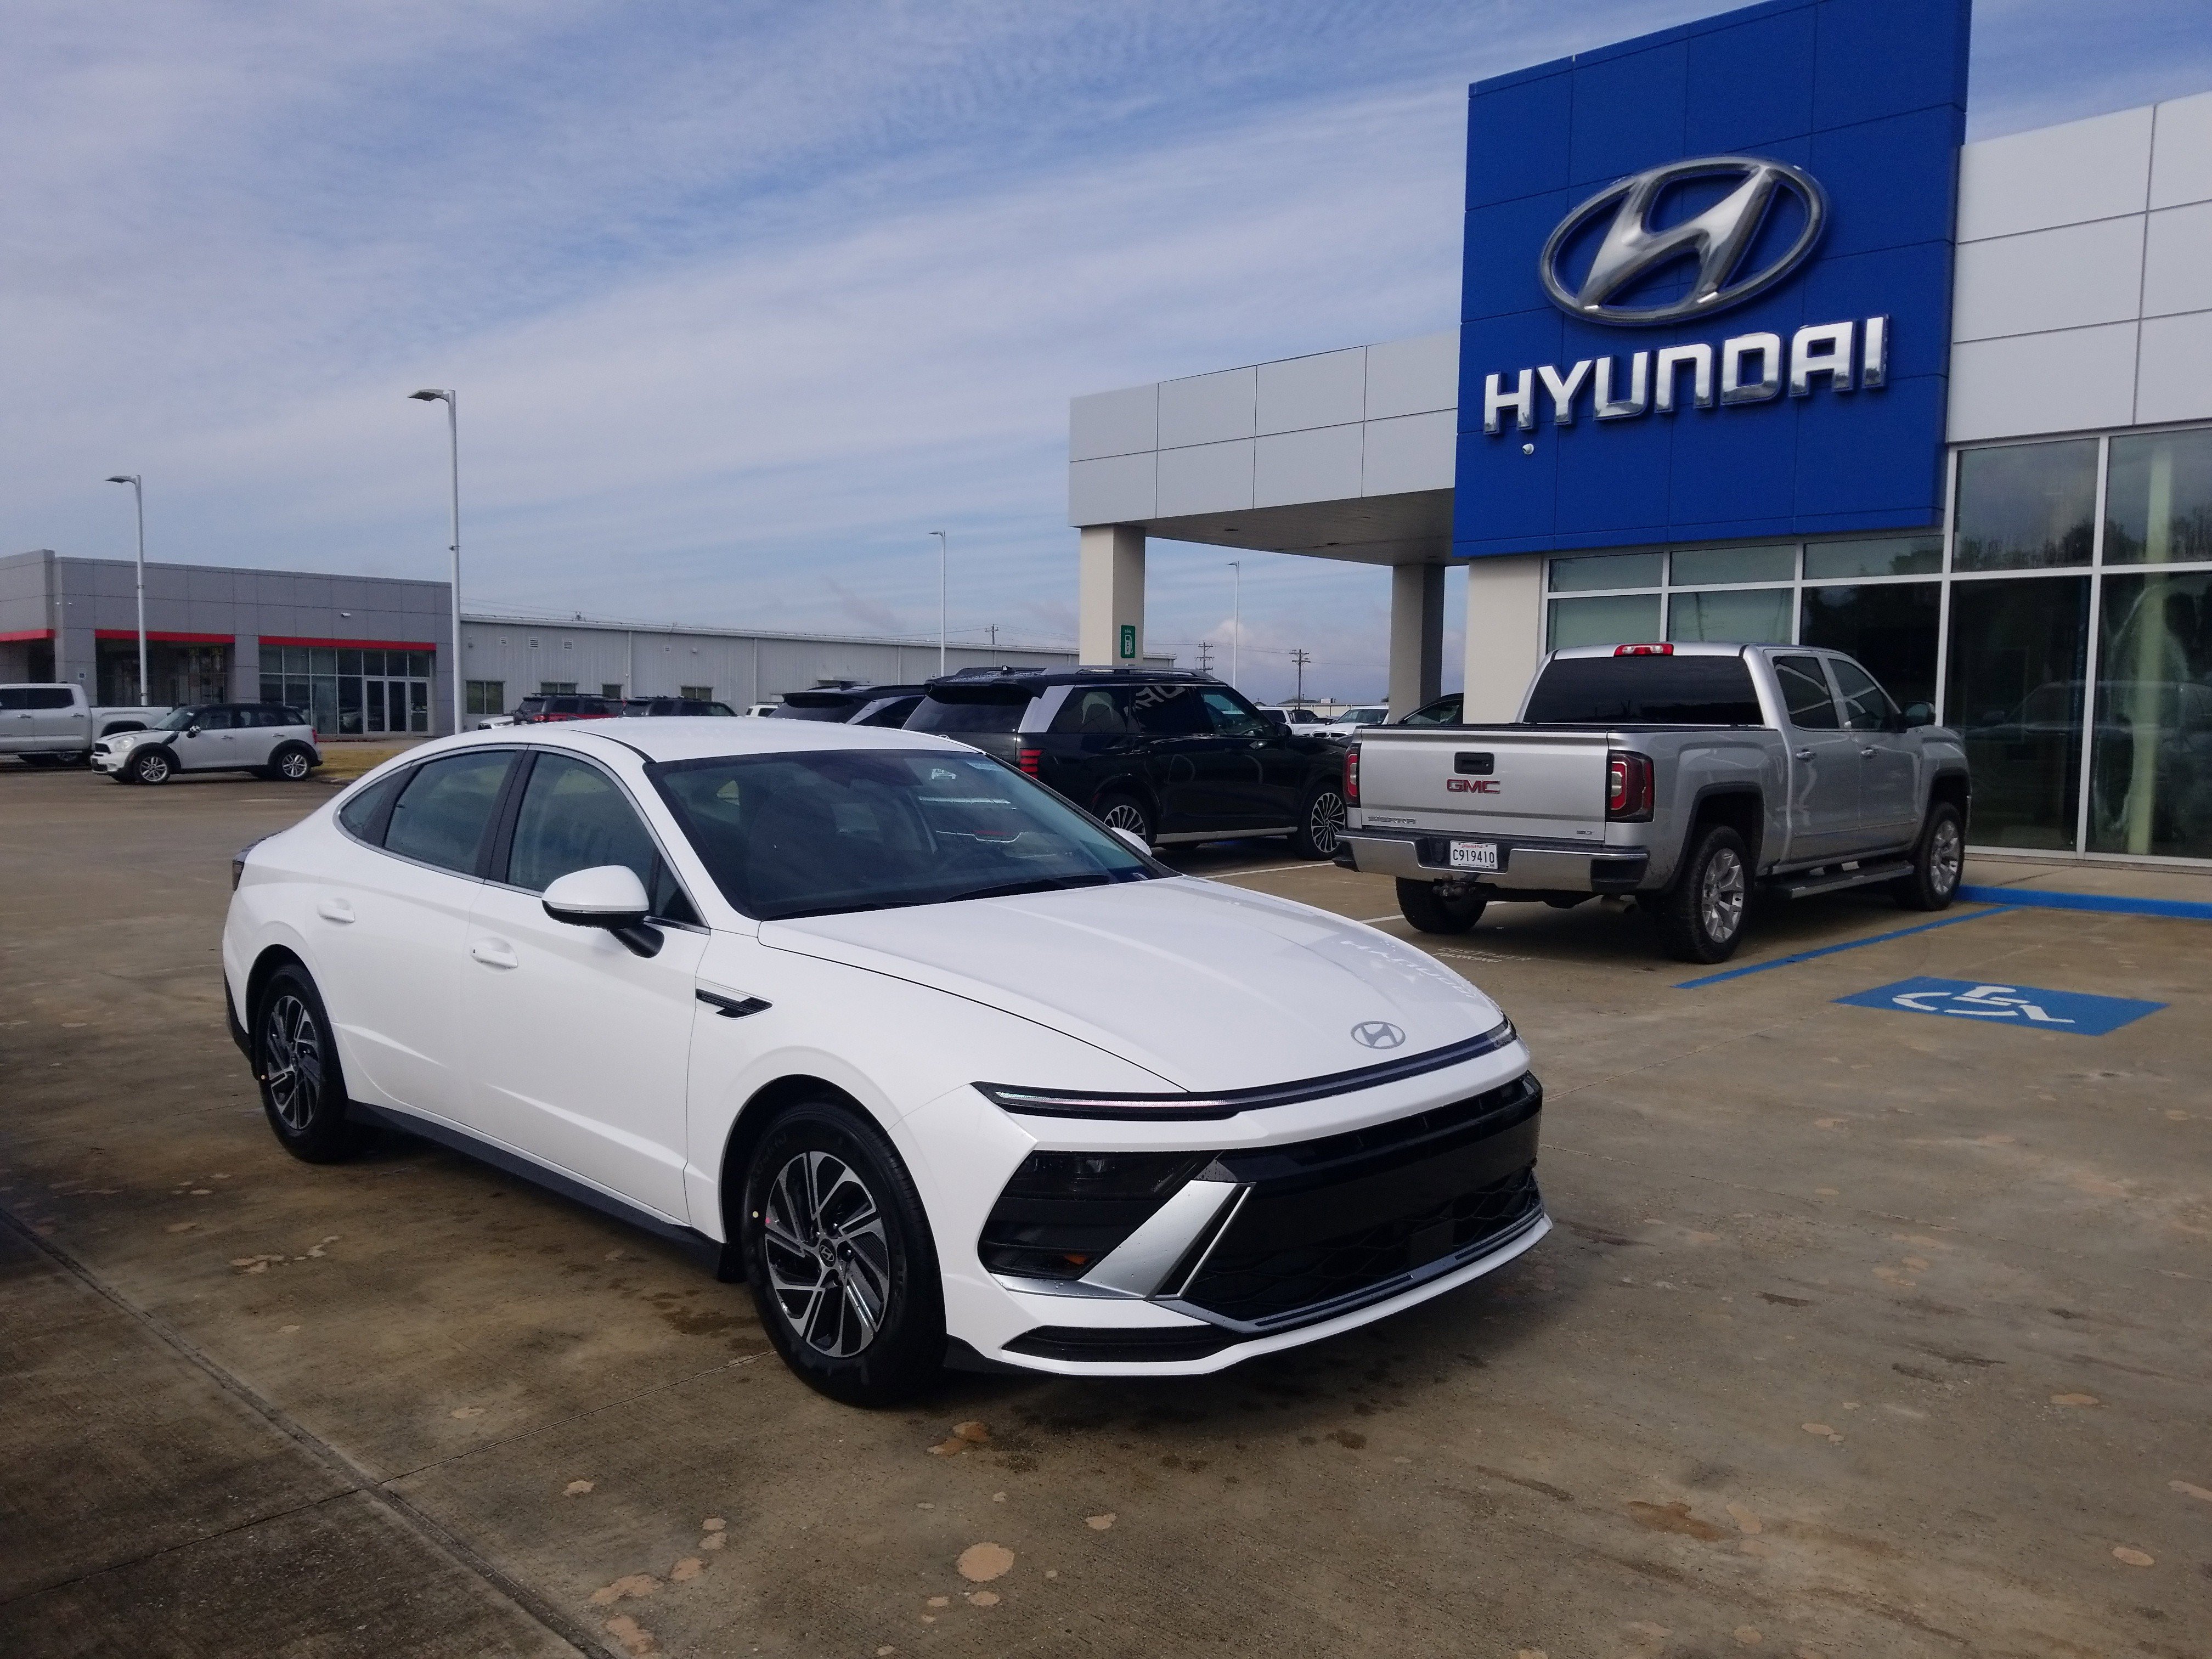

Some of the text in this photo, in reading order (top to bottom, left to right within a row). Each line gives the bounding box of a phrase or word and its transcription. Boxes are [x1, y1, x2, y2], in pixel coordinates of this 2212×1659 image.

[1483, 314, 1888, 435] HYUNDAI
[1447, 779, 1500, 794] GMC
[1368, 815, 1415, 824] SIERRA
[1453, 849, 1494, 864] C919410
